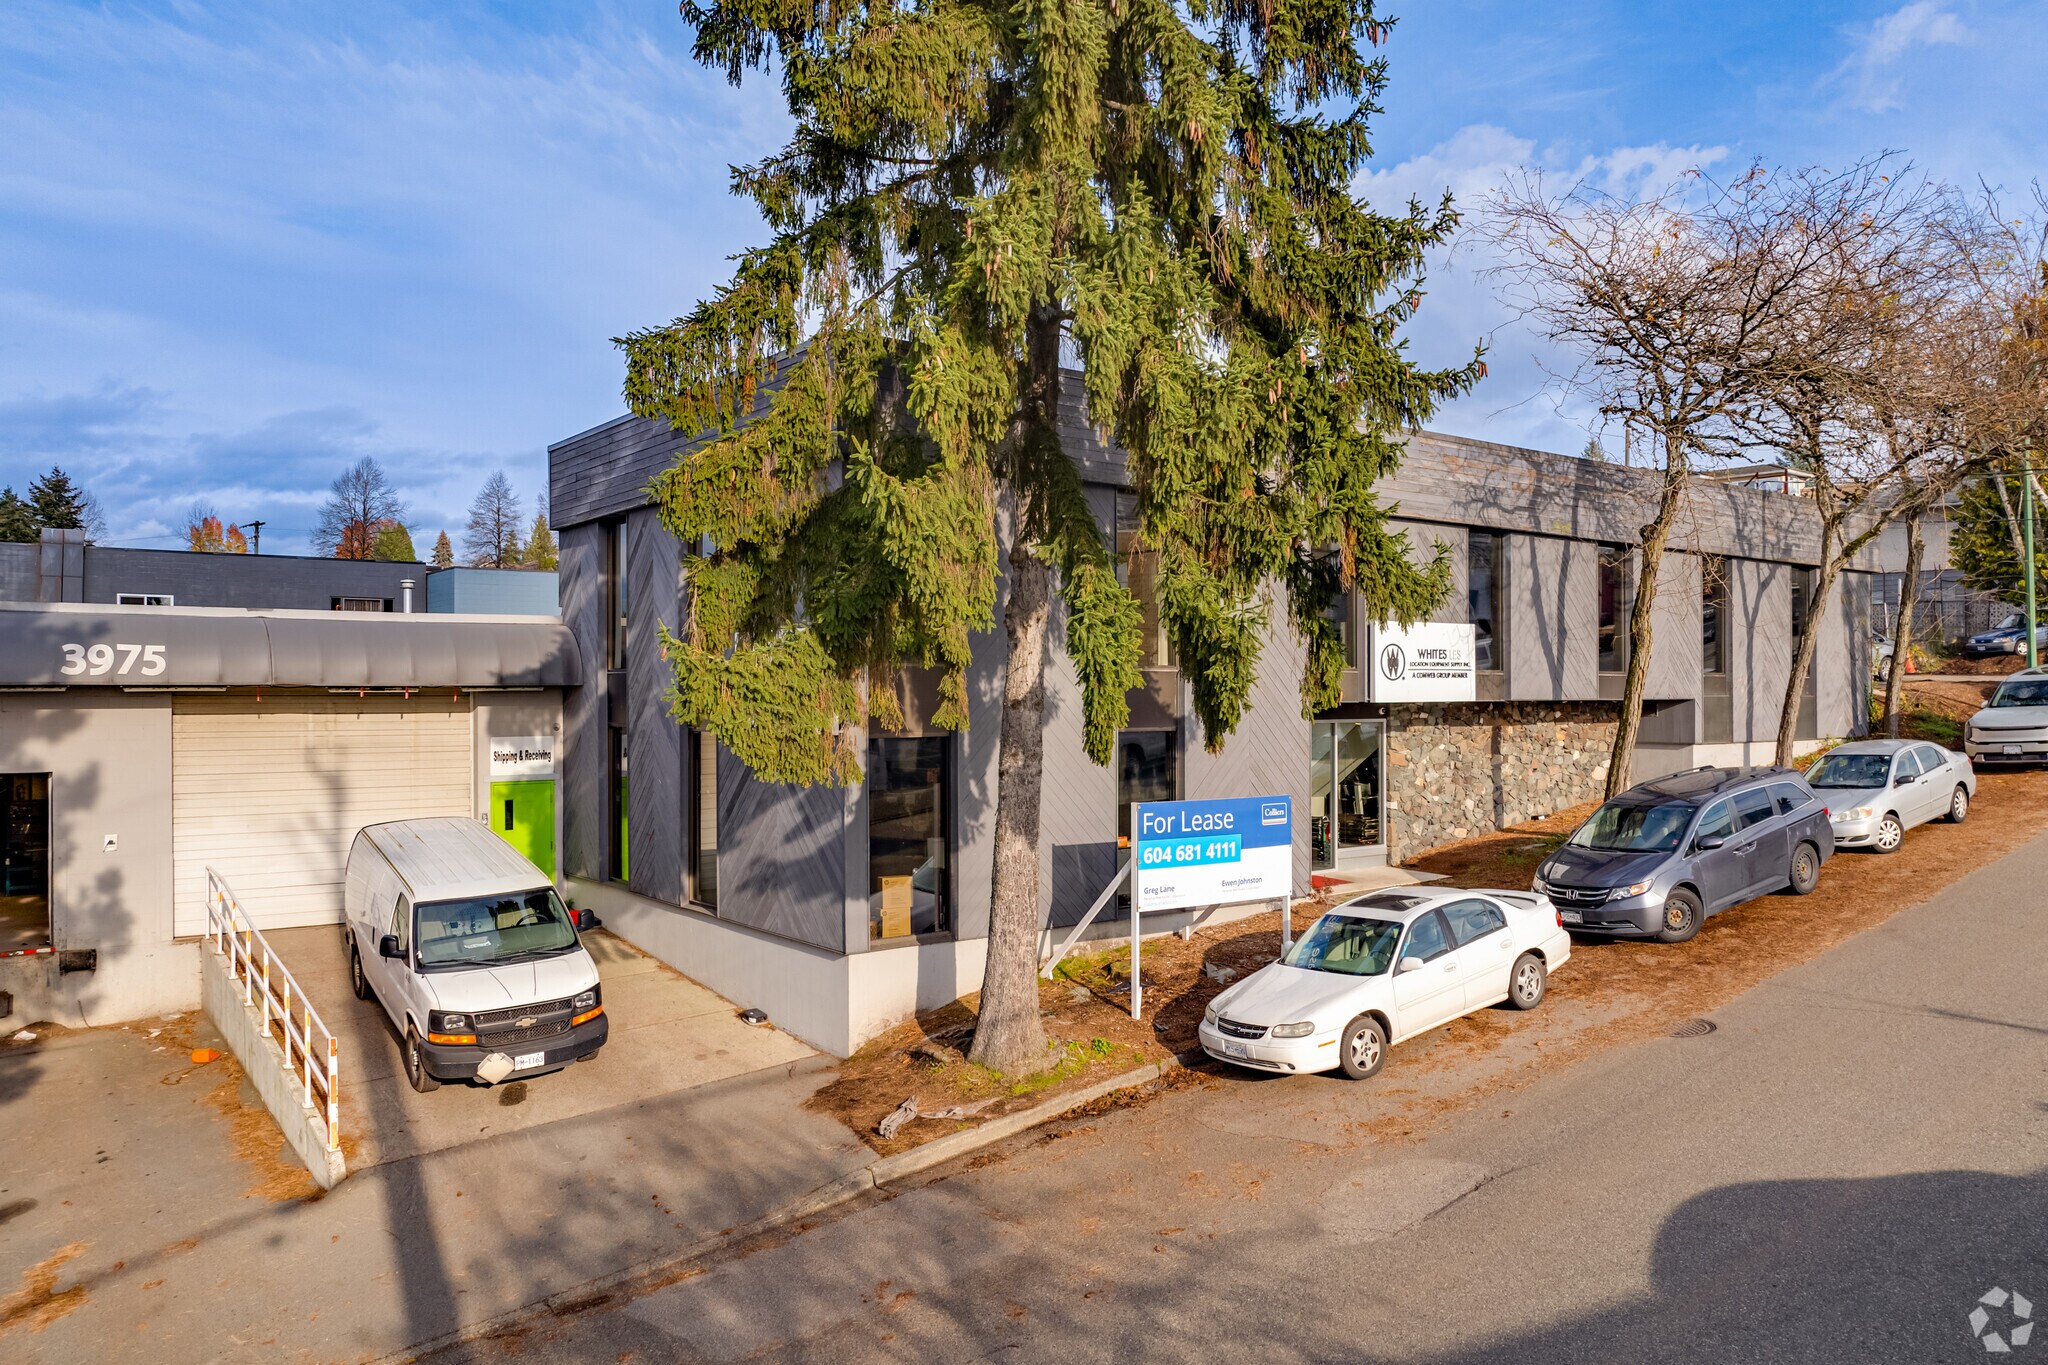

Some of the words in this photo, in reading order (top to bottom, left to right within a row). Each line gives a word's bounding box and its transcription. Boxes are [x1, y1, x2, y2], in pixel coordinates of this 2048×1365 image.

[60, 643, 167, 676] 3975
[1417, 648, 1447, 660] WHITES
[493, 751, 518, 764] Shipping
[519, 750, 523, 761] &
[525, 749, 551, 763] Receiving
[1264, 808, 1285, 817] Colliers
[1143, 812, 1176, 834] For
[1181, 811, 1234, 832] Lease
[1143, 846, 1172, 865] 604
[1175, 844, 1201, 862] 681
[1205, 841, 1236, 859] 4111
[1237, 877, 1263, 887] Johnston
[1143, 887, 1159, 896] Greg
